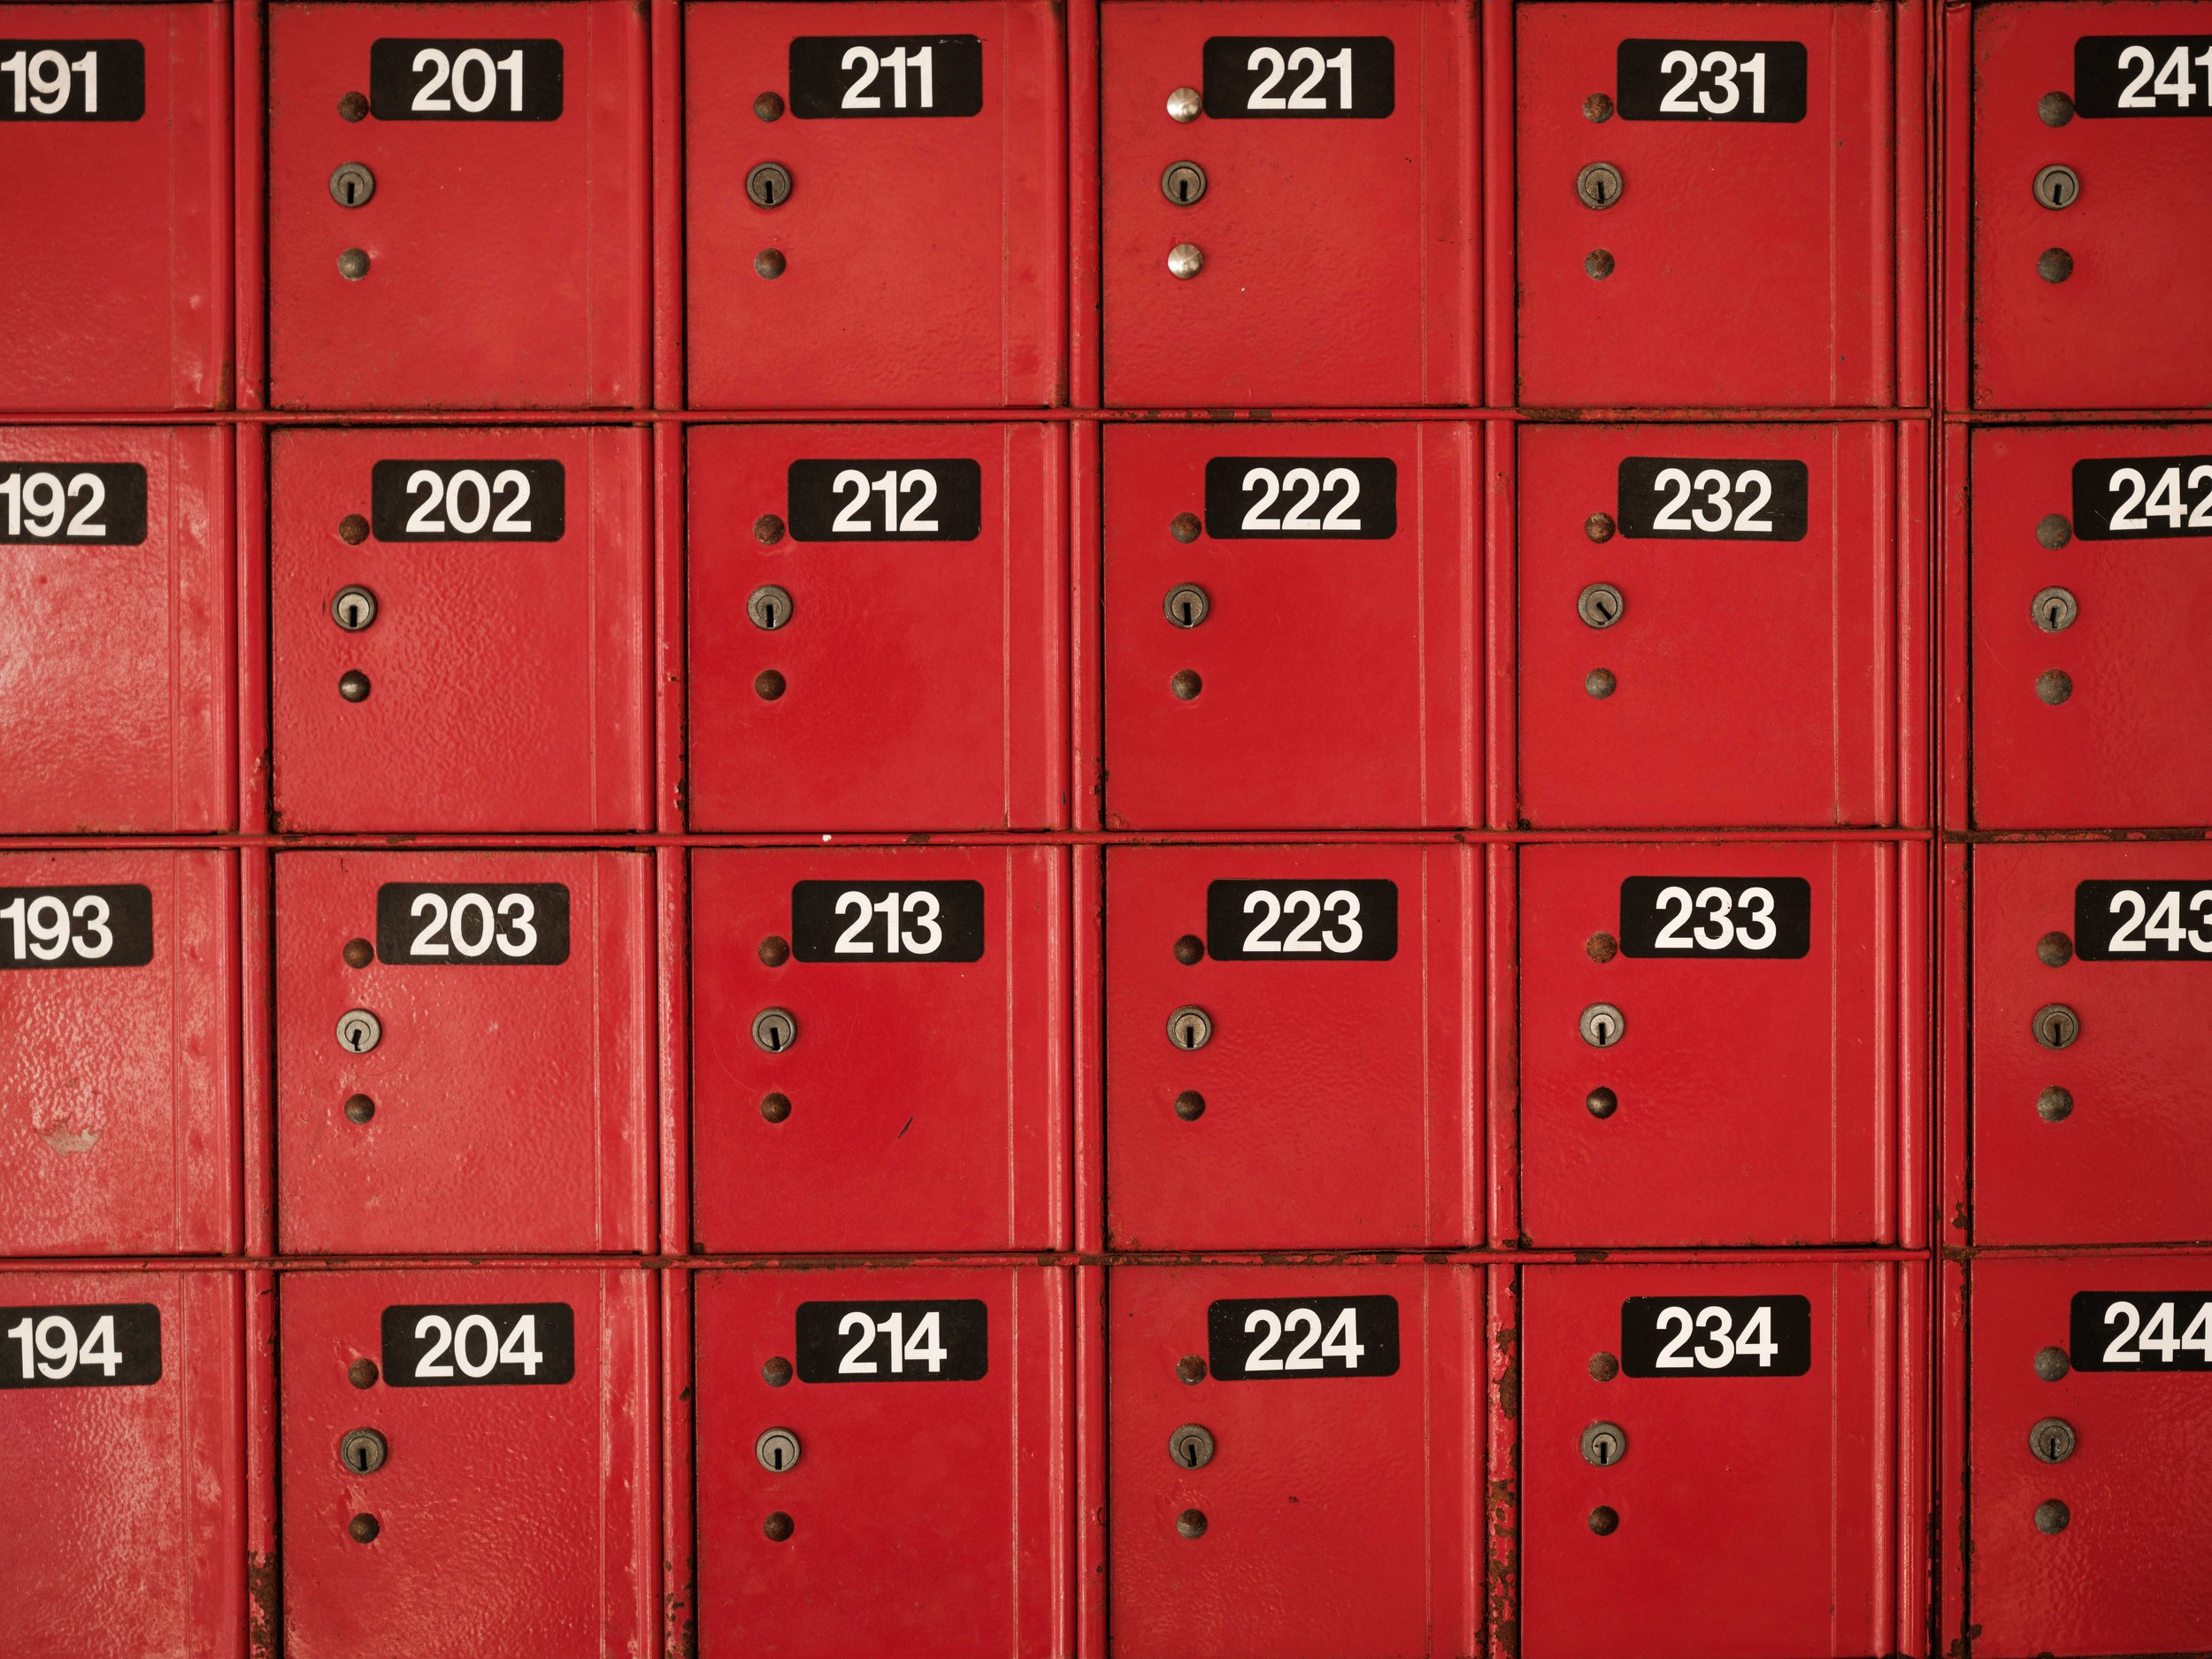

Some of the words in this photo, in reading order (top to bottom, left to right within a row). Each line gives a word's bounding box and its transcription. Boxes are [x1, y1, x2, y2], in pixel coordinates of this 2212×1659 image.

[0, 50, 97, 114] 191
[411, 48, 523, 113] 201
[841, 45, 933, 109] 211
[1247, 46, 1353, 110] 221
[1659, 50, 1765, 114] 231
[0, 472, 106, 538] 192
[405, 469, 532, 534] 202
[832, 468, 939, 532] 212
[1240, 467, 1362, 531] 222
[1652, 467, 1773, 533] 232
[0, 895, 113, 961] 193
[410, 892, 538, 957] 203
[833, 890, 942, 955] 213
[1242, 889, 1363, 954] 223
[1654, 886, 1777, 950] 233
[7, 1314, 123, 1379] 194
[414, 1314, 543, 1379] 204
[838, 1311, 948, 1374] 214
[1244, 1307, 1365, 1371] 224
[1655, 1305, 1778, 1369] 234
